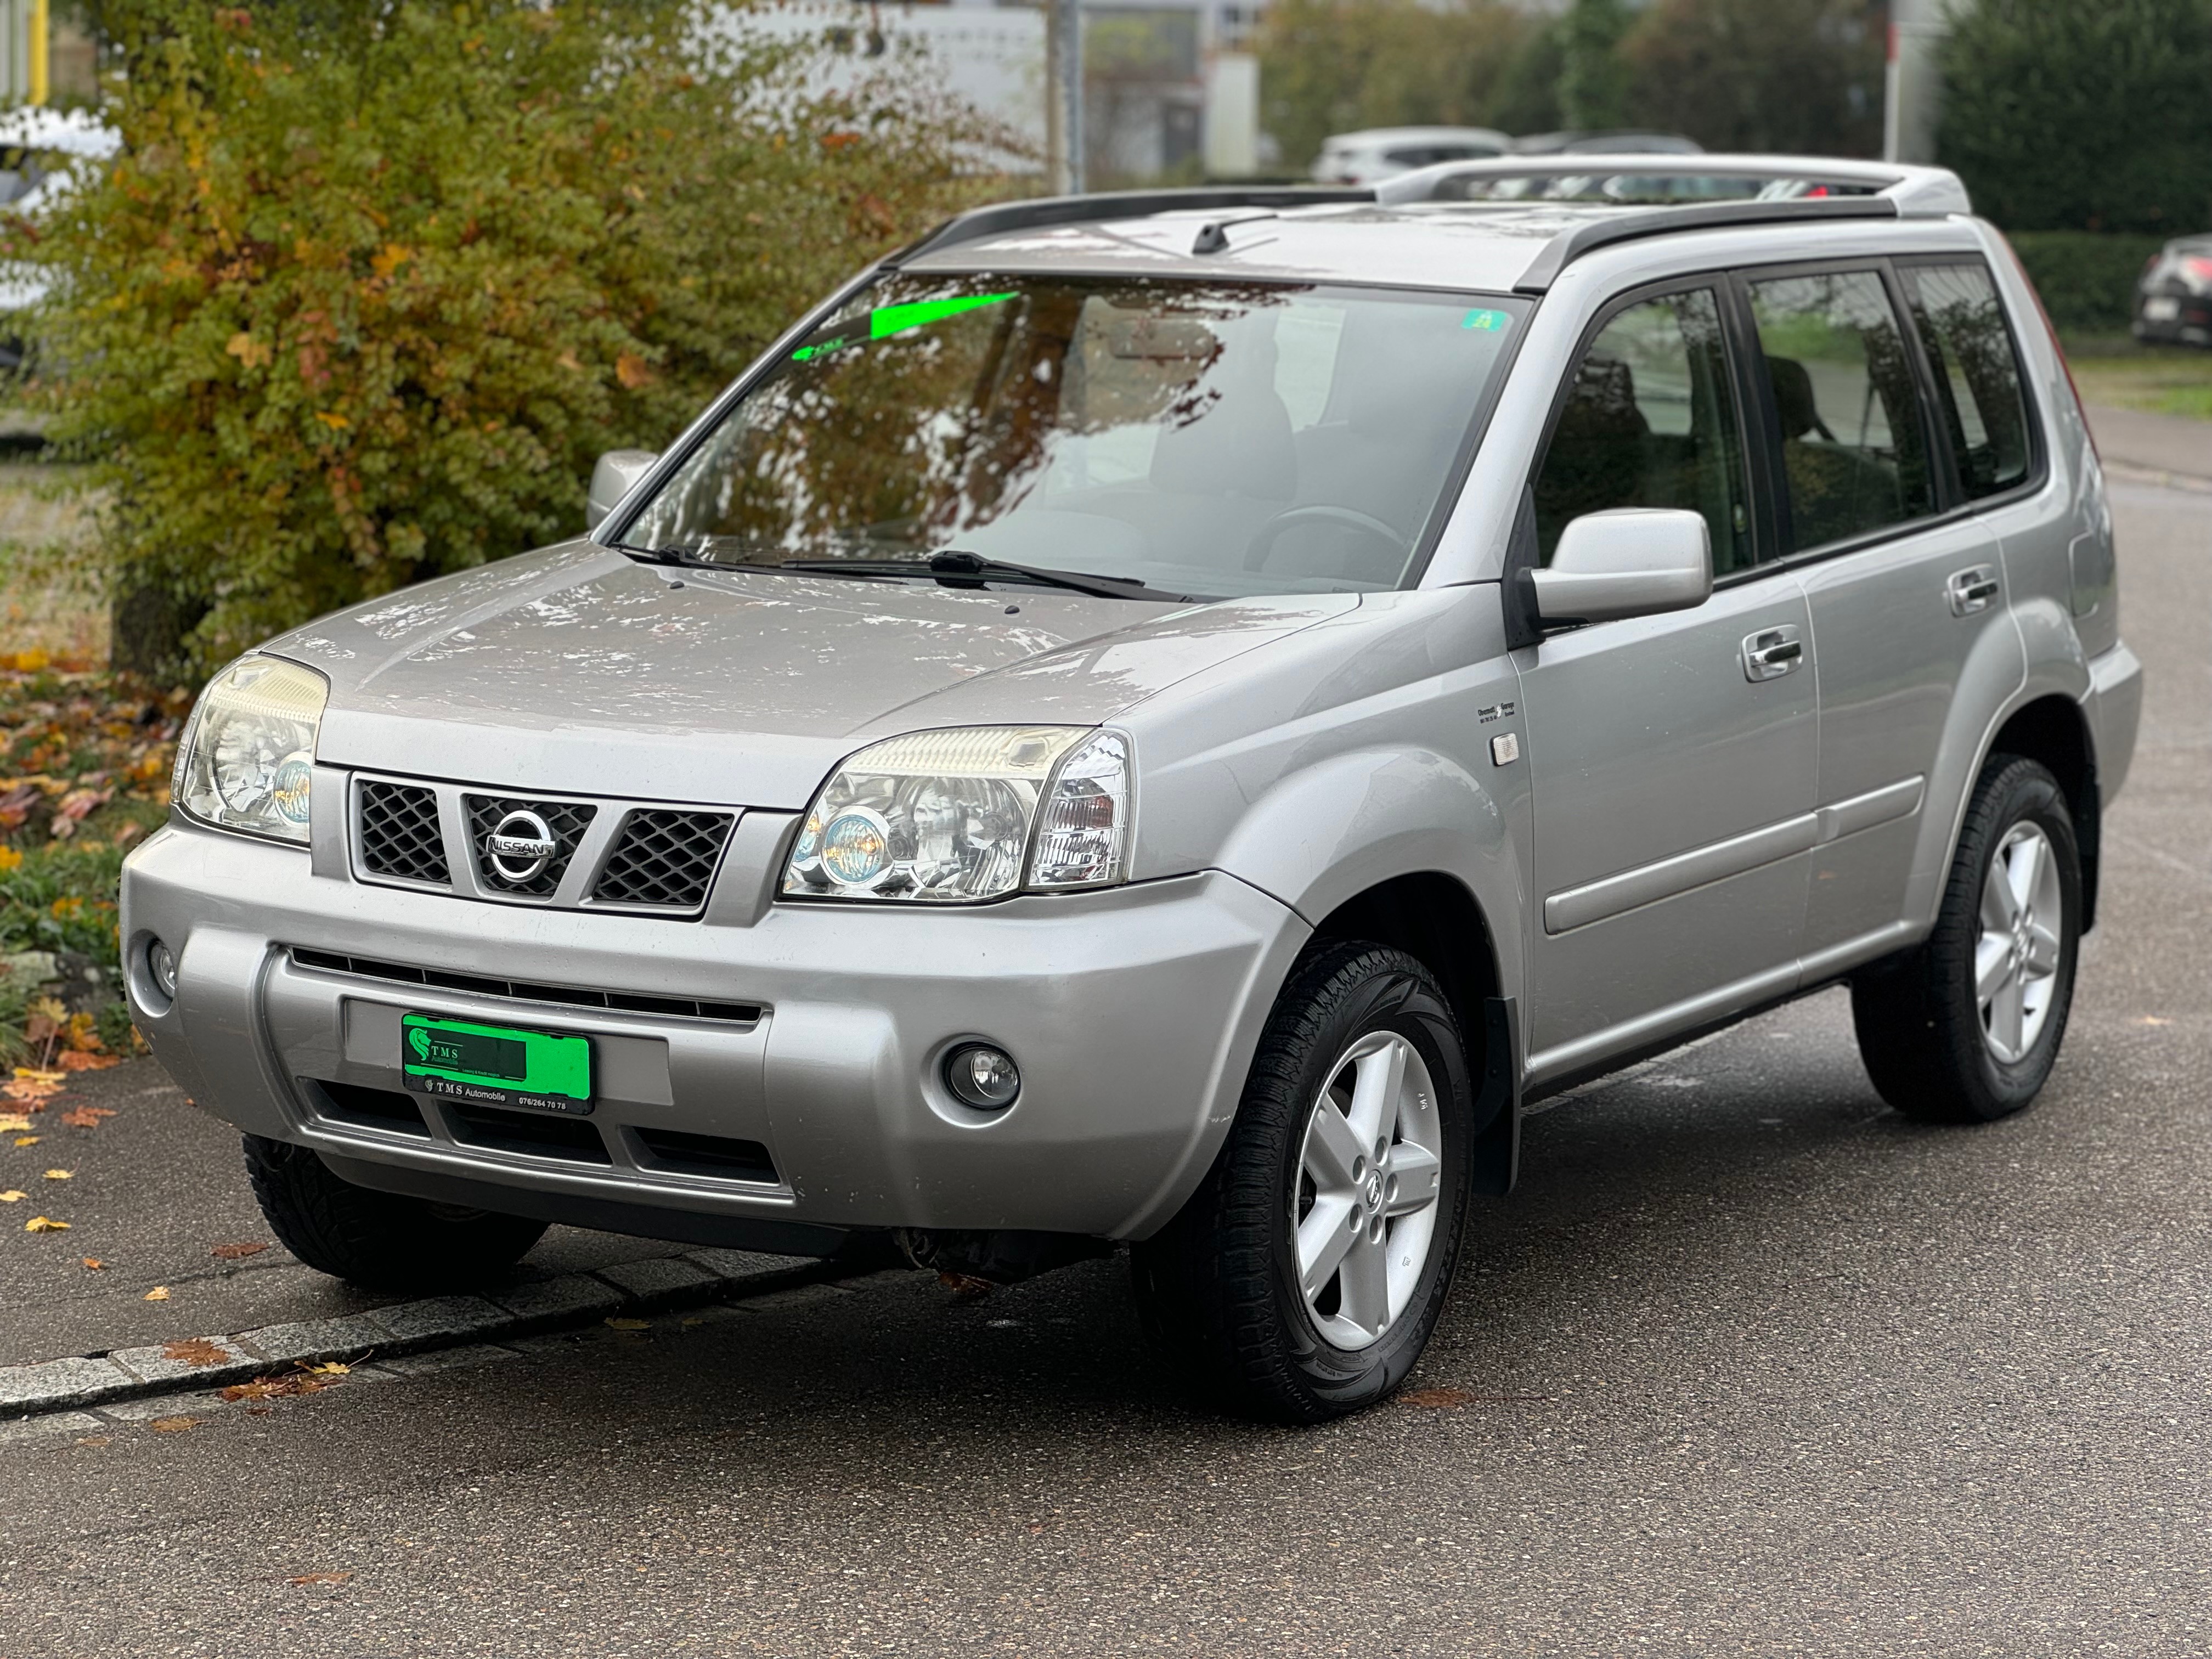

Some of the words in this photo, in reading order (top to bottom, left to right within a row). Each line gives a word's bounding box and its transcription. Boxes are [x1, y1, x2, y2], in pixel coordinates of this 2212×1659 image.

[489, 837, 544, 854] NISSAN
[465, 1088, 506, 1101] Automobile
[519, 1097, 546, 1107] 076/264
